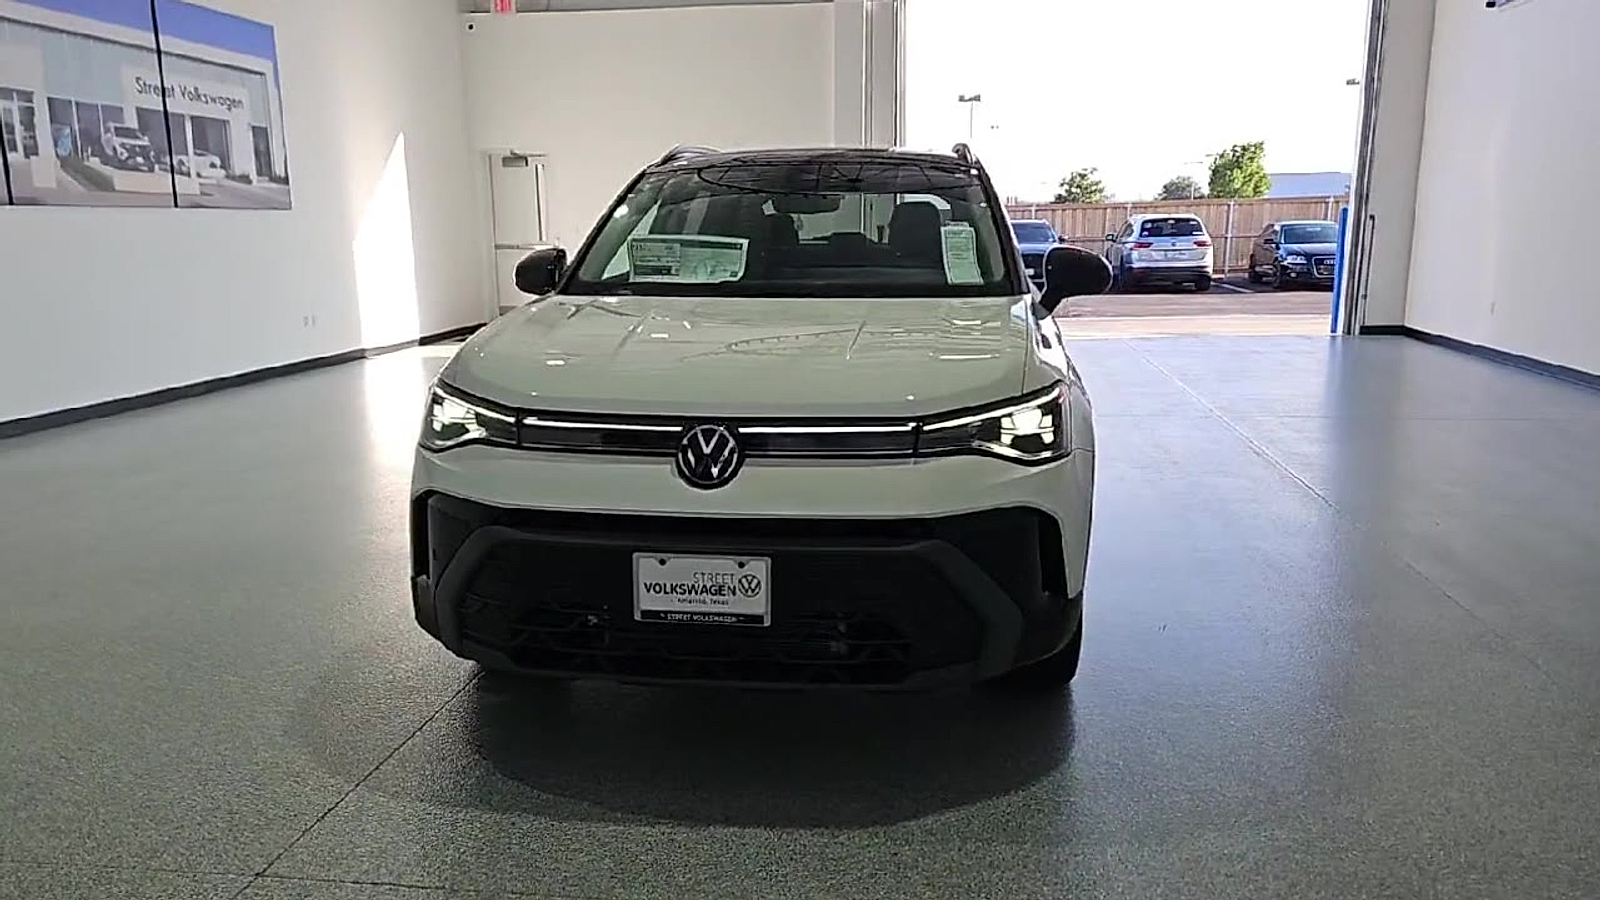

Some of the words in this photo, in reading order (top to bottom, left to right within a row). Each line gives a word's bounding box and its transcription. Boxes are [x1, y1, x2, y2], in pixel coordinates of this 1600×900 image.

[178, 83, 244, 112] Volkswagen
[693, 571, 735, 585] STREET
[643, 581, 737, 597] VOLKSWAGEN
